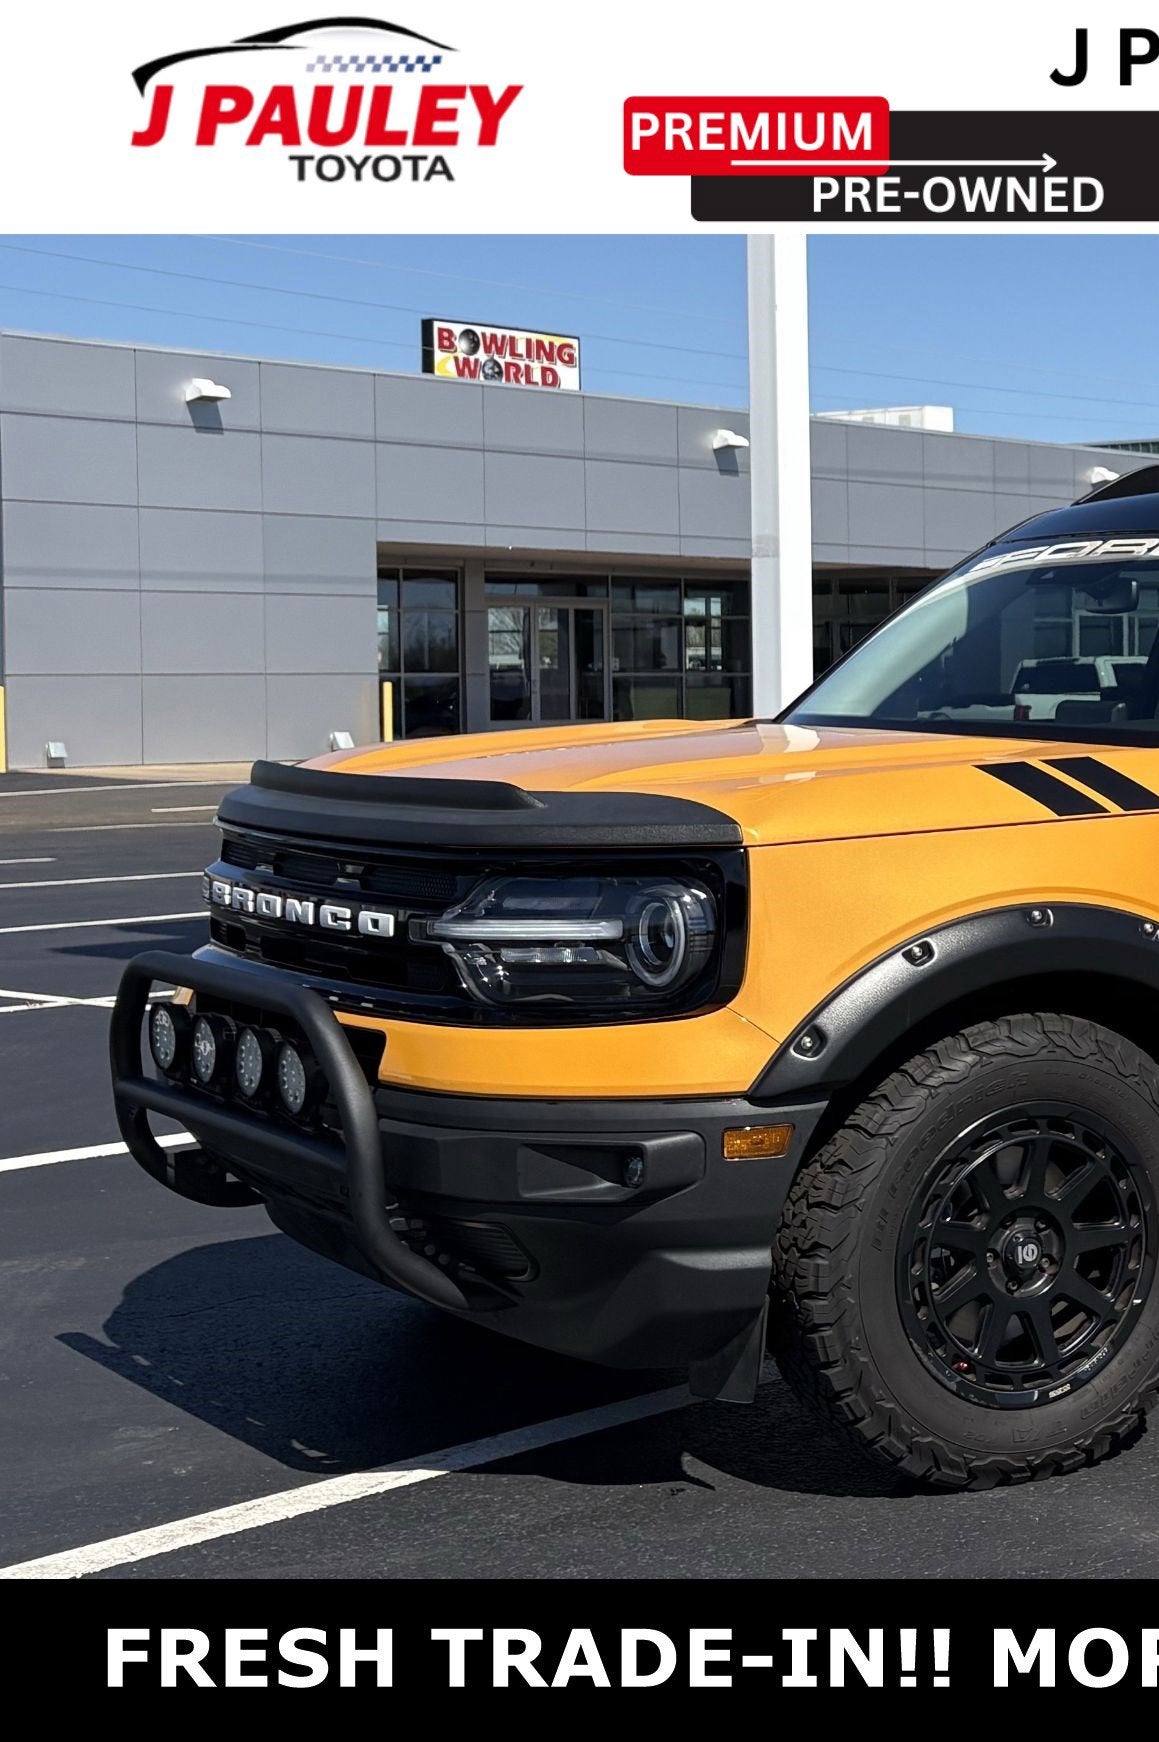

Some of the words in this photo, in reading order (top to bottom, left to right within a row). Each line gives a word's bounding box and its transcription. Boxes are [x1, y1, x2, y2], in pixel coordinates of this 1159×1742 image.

[437, 327, 576, 366] BOWLING
[454, 356, 559, 388] WORLD
[212, 880, 395, 938] BRONCO
